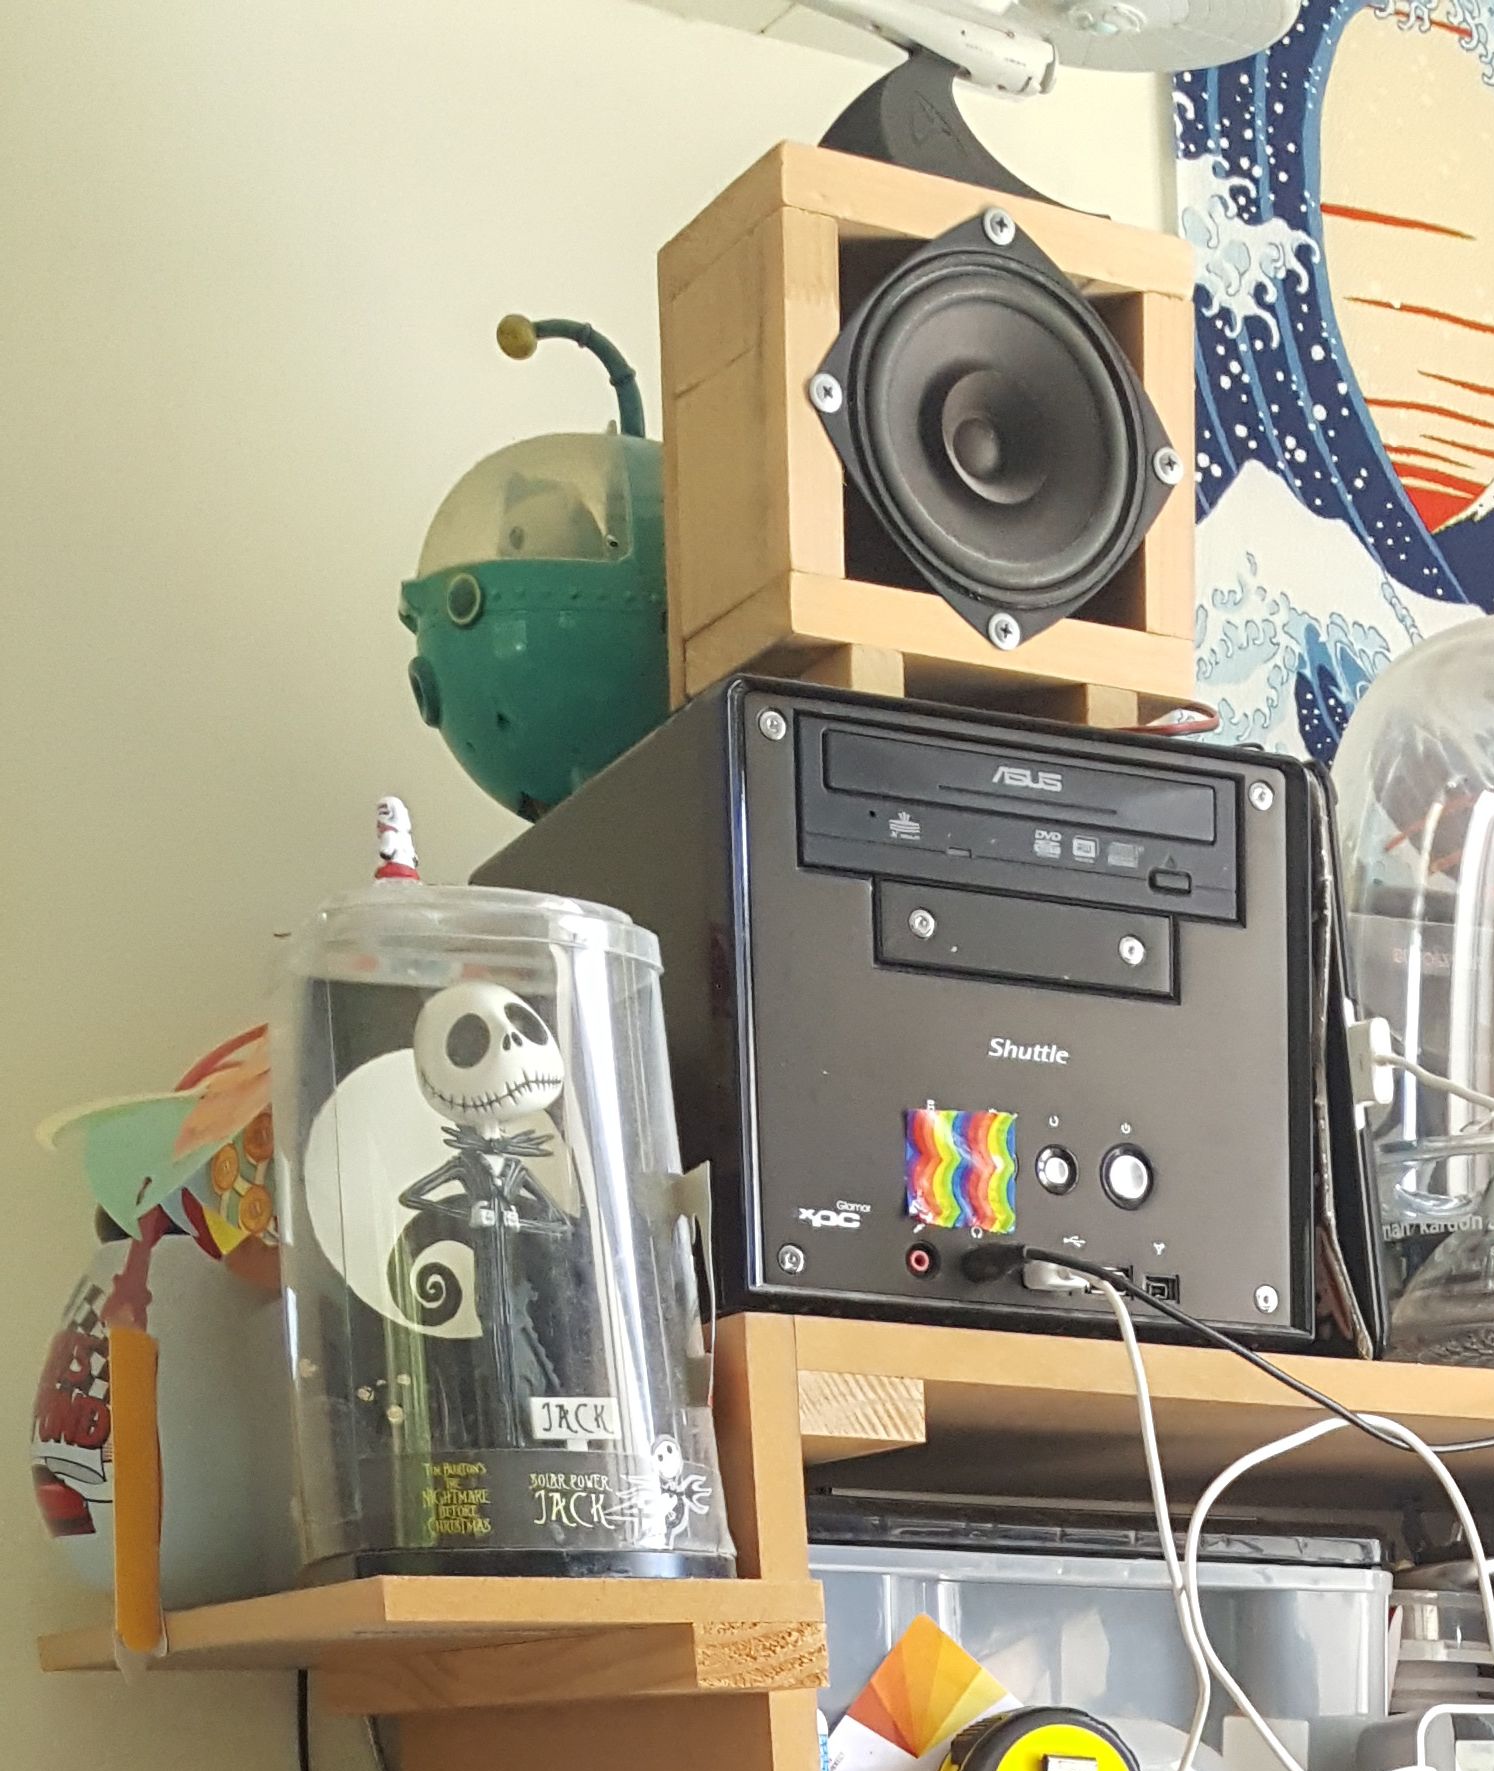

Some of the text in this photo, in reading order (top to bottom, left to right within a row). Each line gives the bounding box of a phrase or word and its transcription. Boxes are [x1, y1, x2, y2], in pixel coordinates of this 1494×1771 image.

[992, 764, 1063, 793] ASUS
[1034, 829, 1062, 841] DVD
[988, 1037, 1069, 1065] Shuttle
[542, 1402, 615, 1435] JACK
[570, 1474, 613, 1491] POWER
[533, 1492, 615, 1530] JACK
